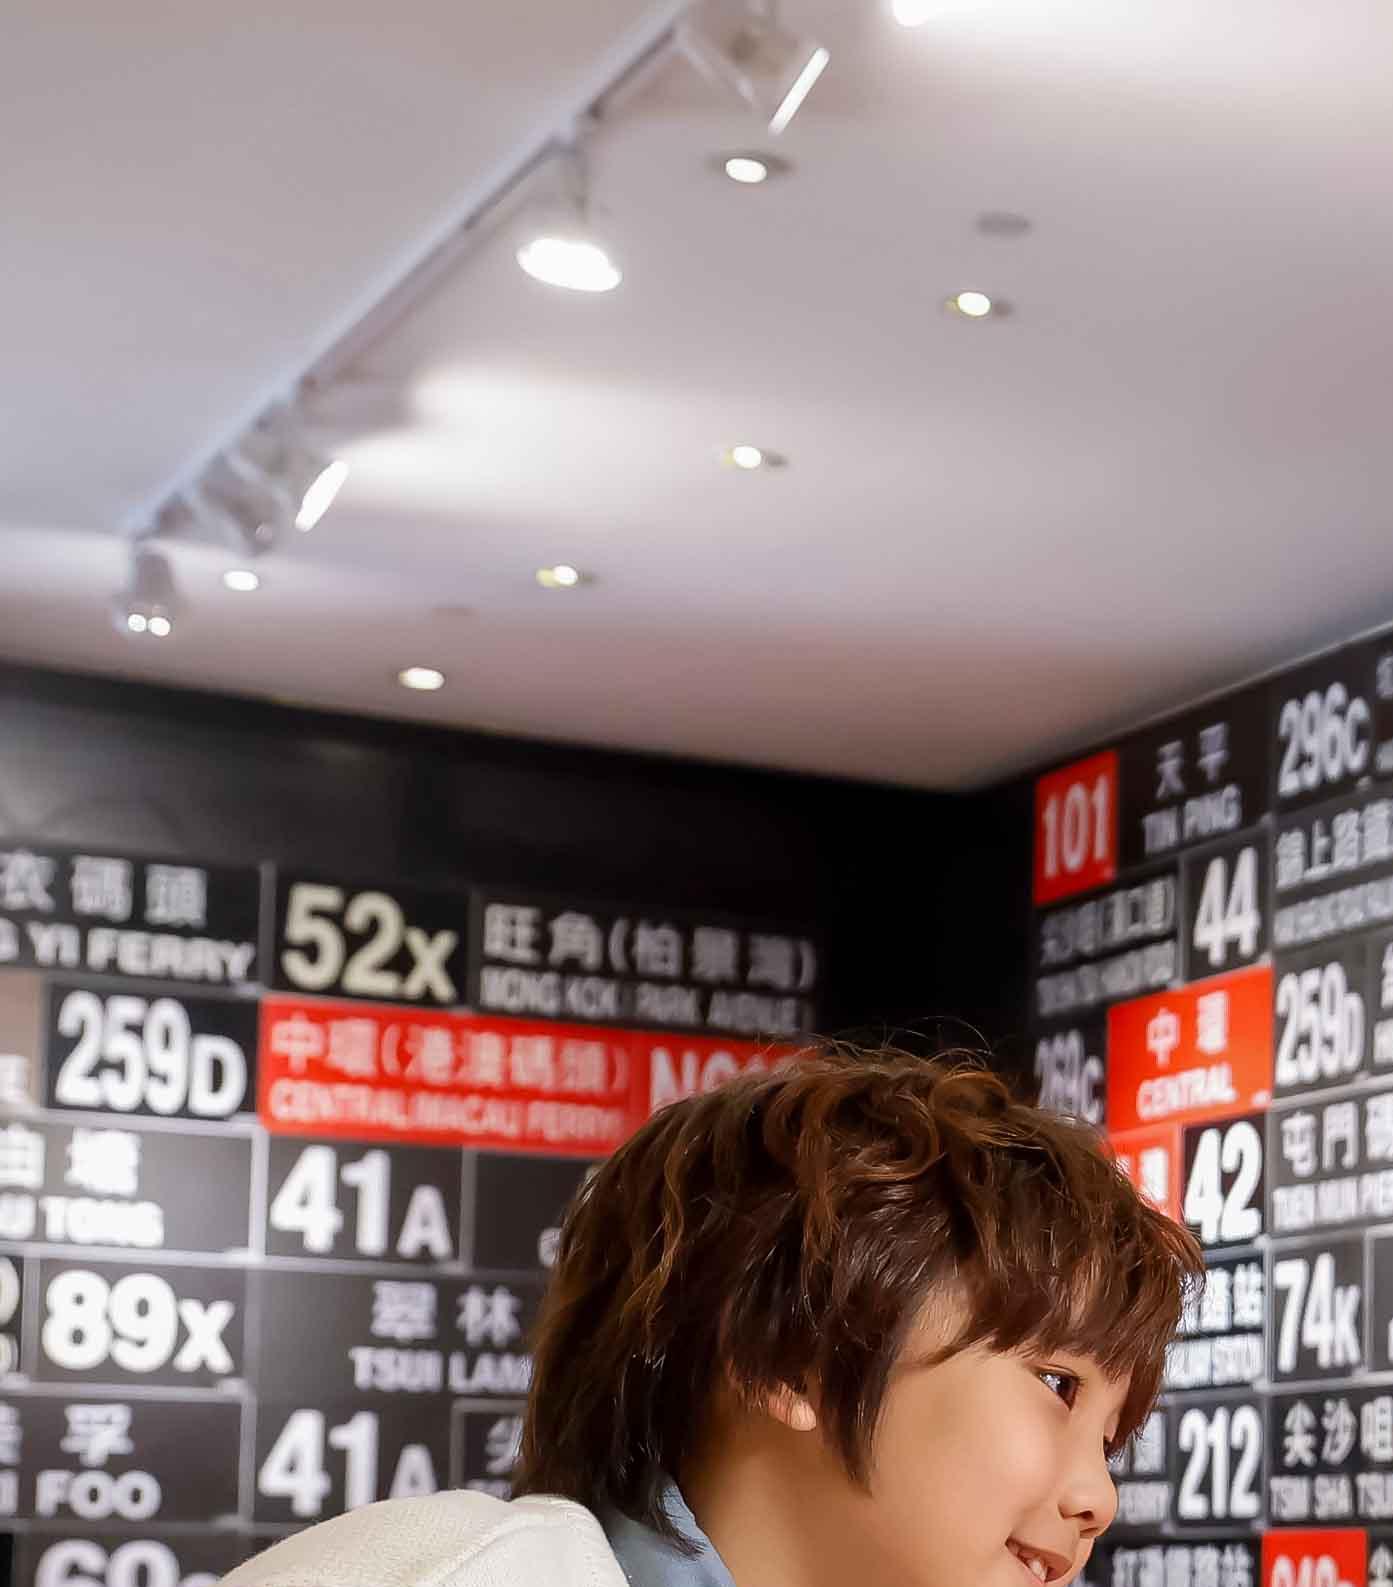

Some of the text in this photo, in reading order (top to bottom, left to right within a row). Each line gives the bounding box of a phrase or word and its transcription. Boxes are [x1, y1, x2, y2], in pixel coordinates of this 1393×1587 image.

[1042, 774, 1110, 881] 101
[281, 881, 458, 1003] 52X
[1192, 848, 1262, 966] 44
[55, 989, 249, 1120] 259D
[1275, 962, 1366, 1085] 259D
[269, 1144, 454, 1260] 41A
[1185, 1120, 1263, 1244] 42
[41, 1268, 236, 1375] 89X
[1273, 1252, 1362, 1374] 74K
[35, 1469, 162, 1521] FOO
[257, 1408, 440, 1518] 41A
[1177, 1404, 1263, 1520] 212
